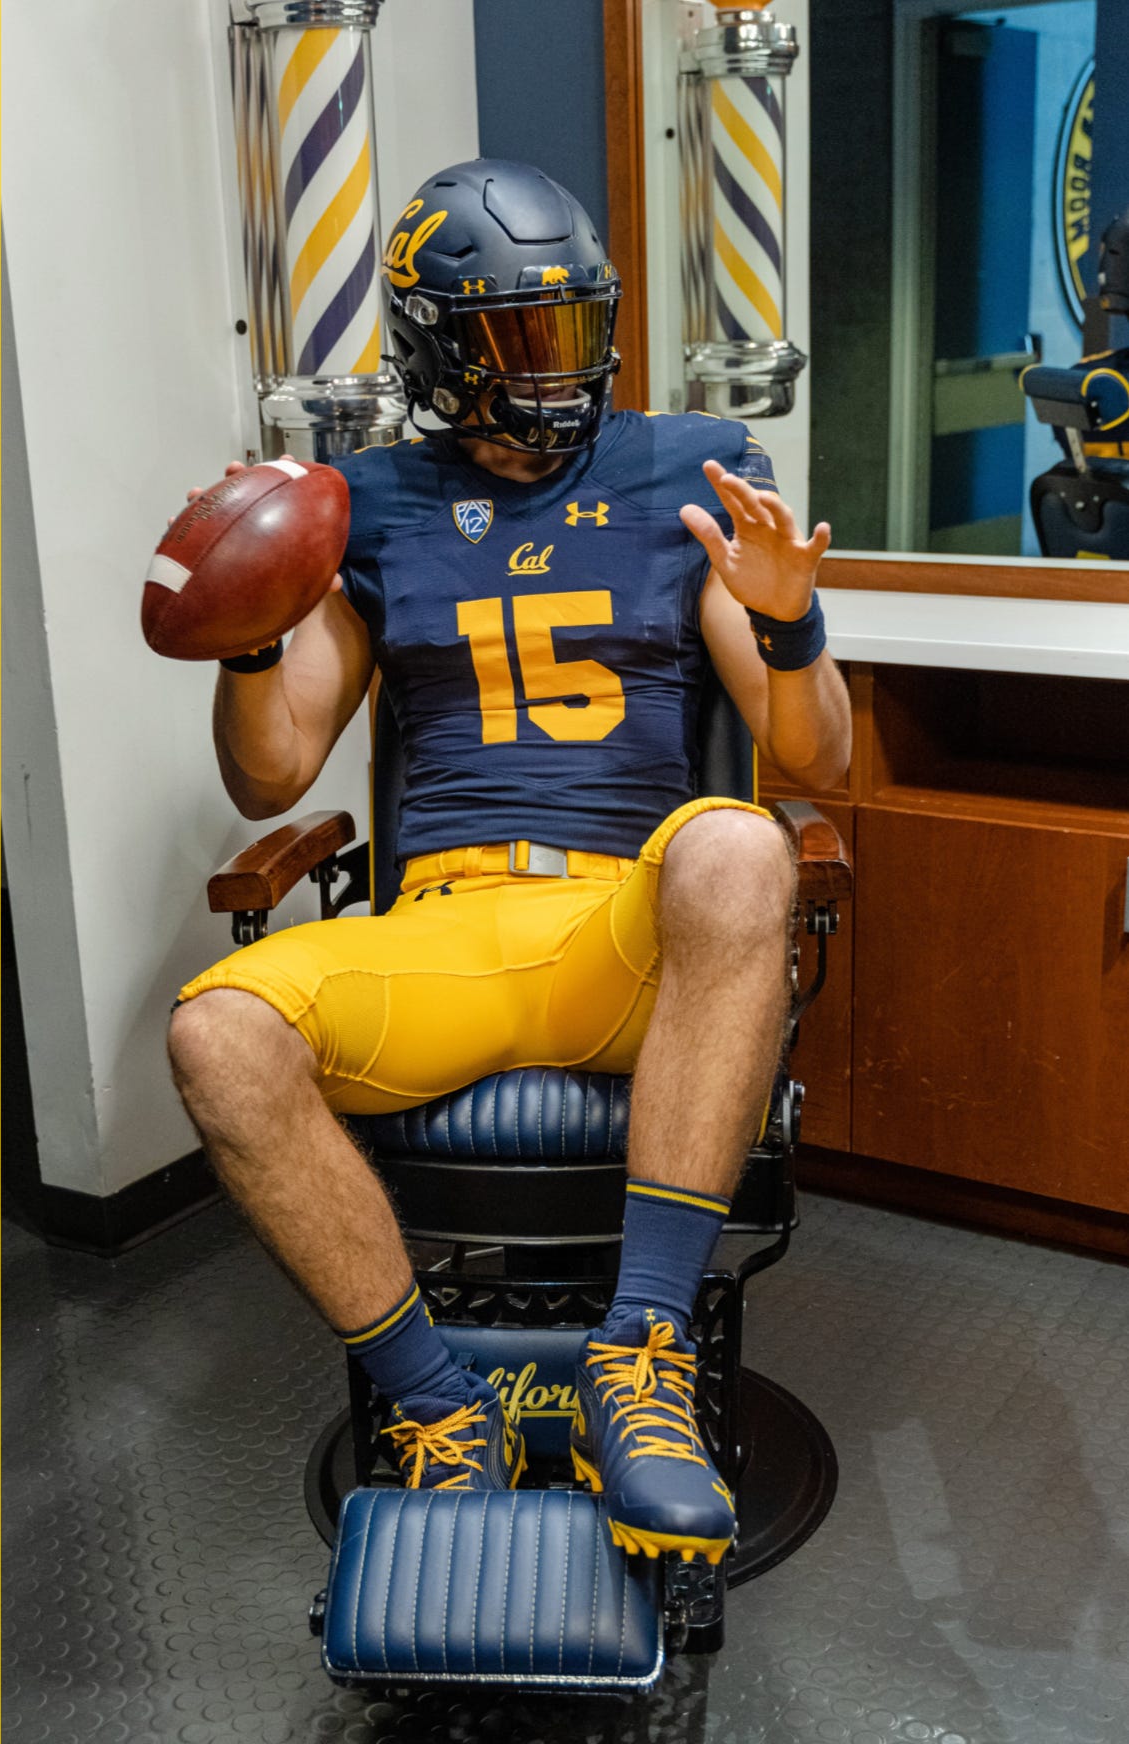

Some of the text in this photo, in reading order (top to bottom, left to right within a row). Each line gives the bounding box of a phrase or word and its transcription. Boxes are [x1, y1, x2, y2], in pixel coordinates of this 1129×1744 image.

[381, 198, 448, 288] Cal
[455, 499, 492, 524] PAC
[464, 516, 483, 535] 12
[505, 542, 554, 576] Cal
[456, 590, 626, 744] 15
